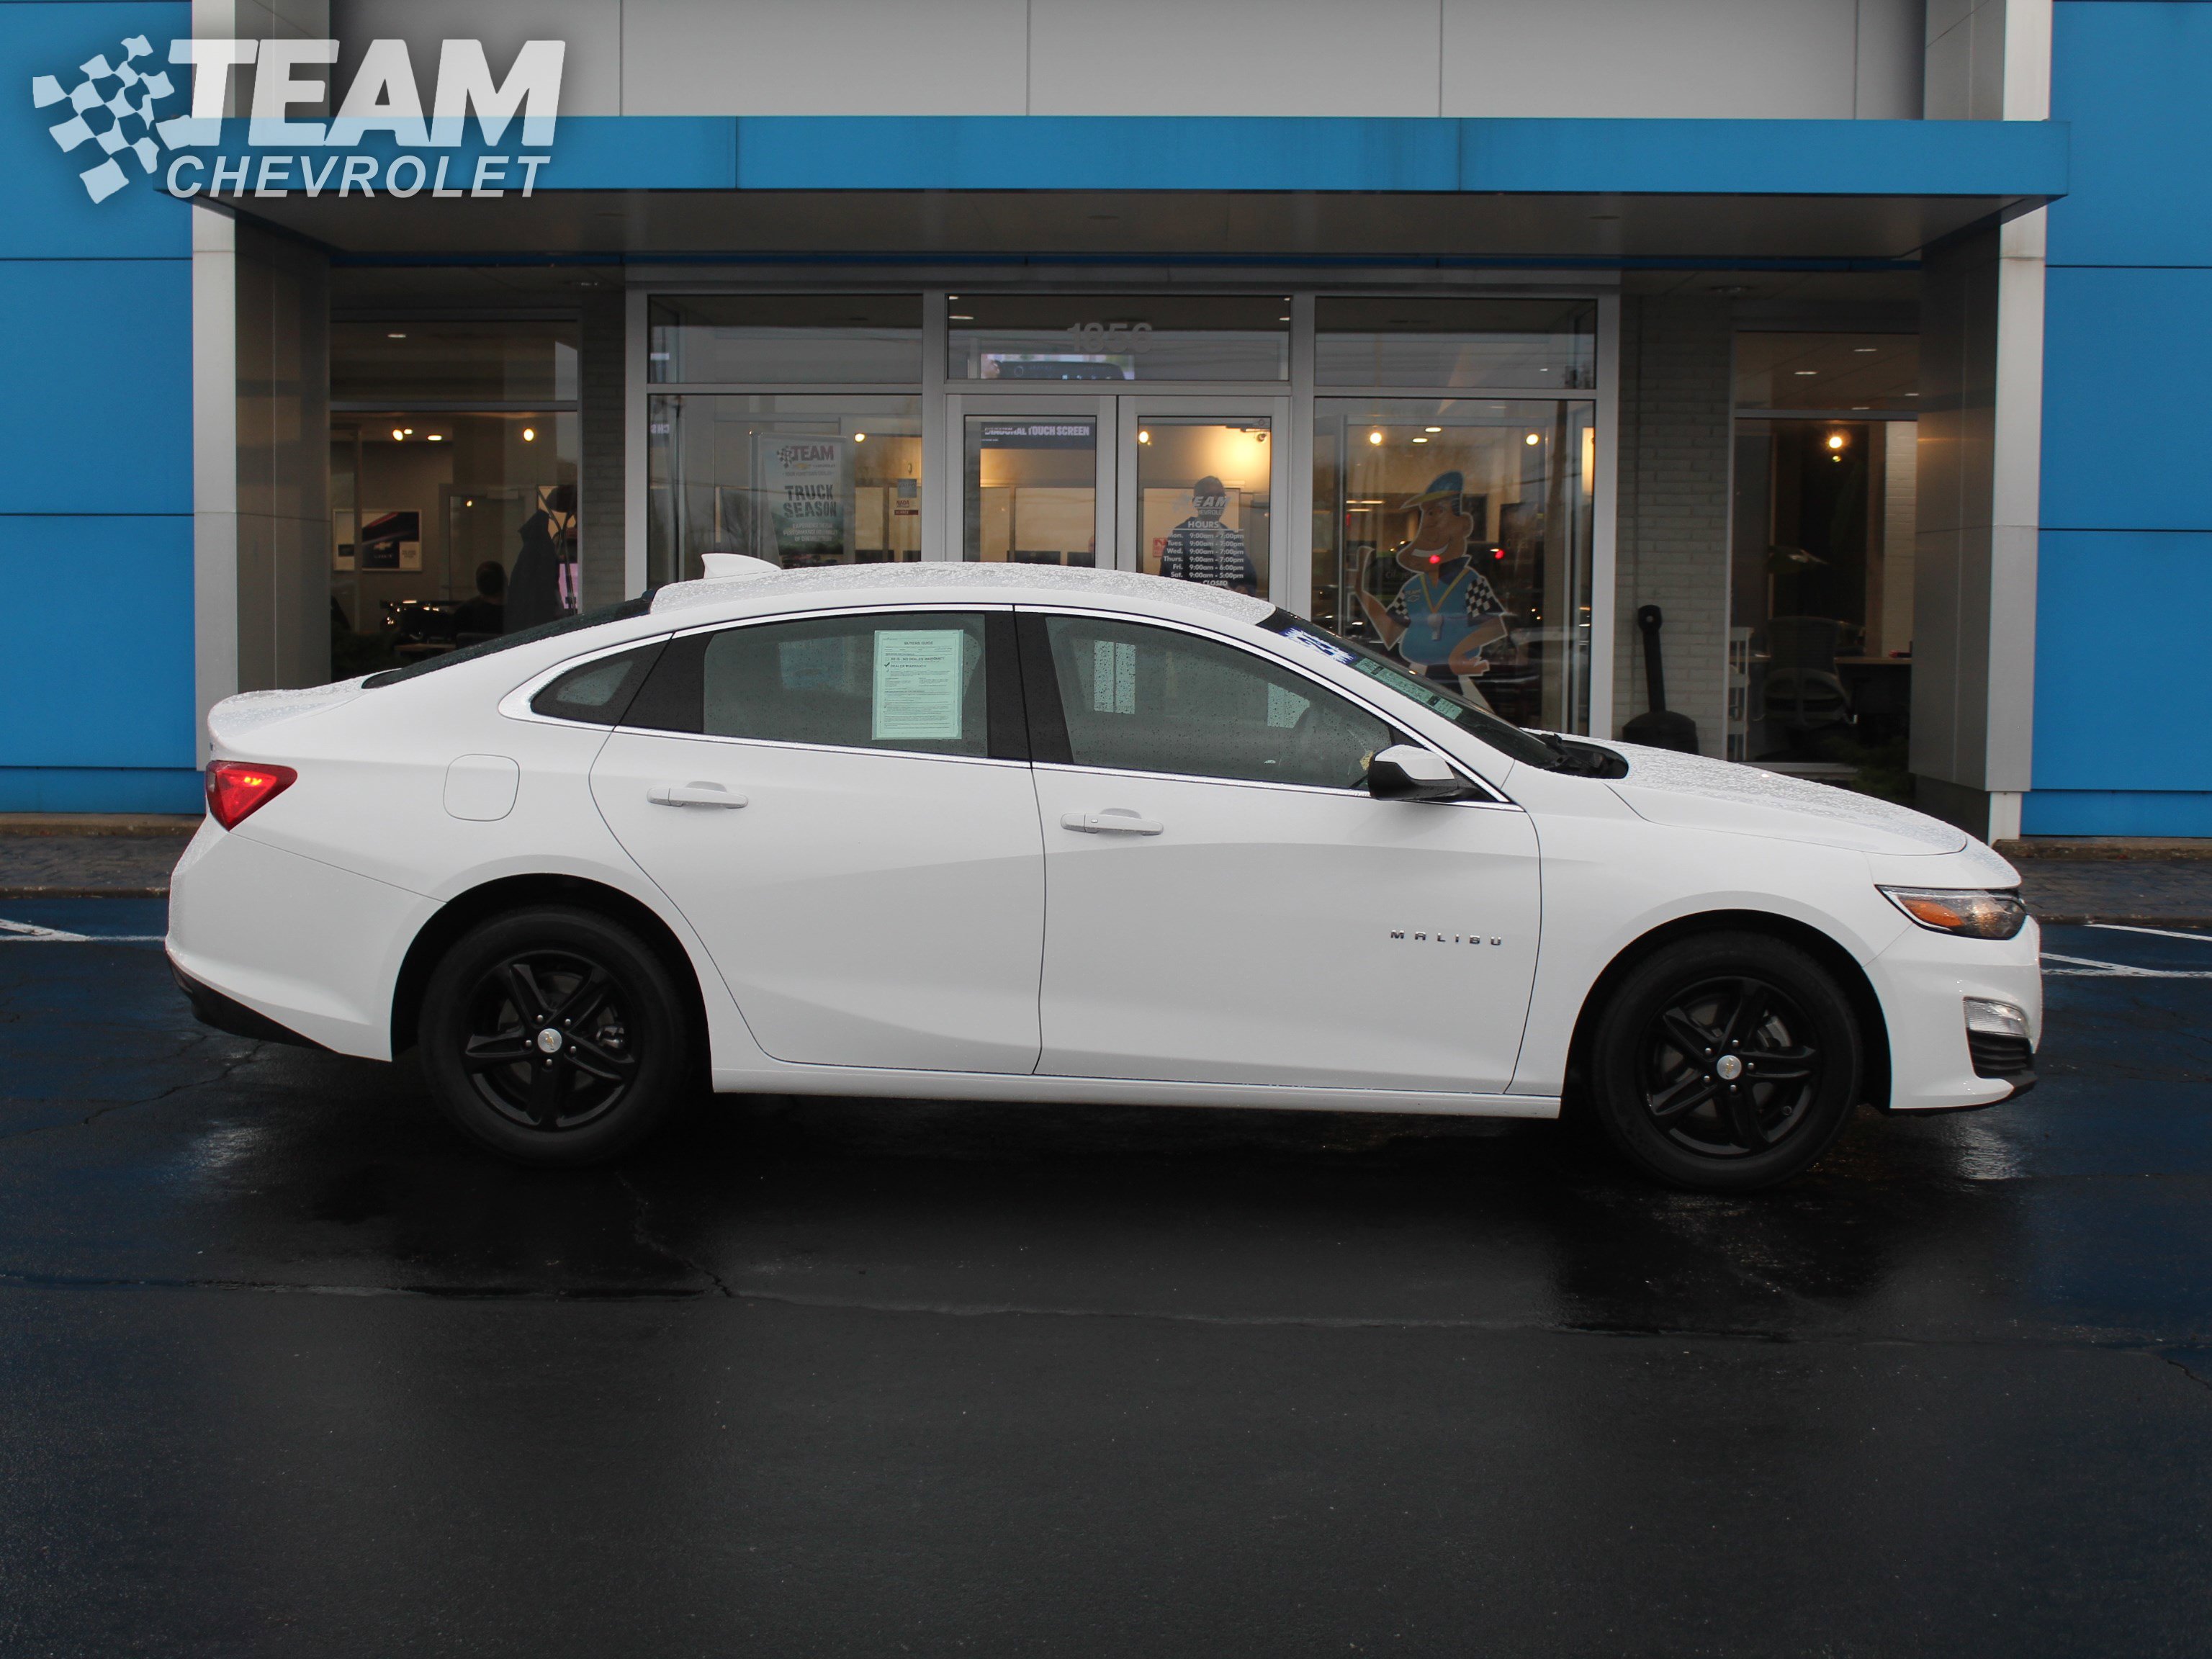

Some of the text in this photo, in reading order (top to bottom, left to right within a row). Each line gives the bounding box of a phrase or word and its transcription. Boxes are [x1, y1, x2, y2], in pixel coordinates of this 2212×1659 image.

[1067, 323, 1153, 354] 1856
[1028, 426, 1056, 436] TOUCH
[1056, 426, 1090, 436] SCREEN
[791, 445, 835, 461] TEAM
[784, 484, 834, 501] TRUCK
[783, 501, 837, 518] SEASON
[1390, 930, 1501, 946] MALIBU
